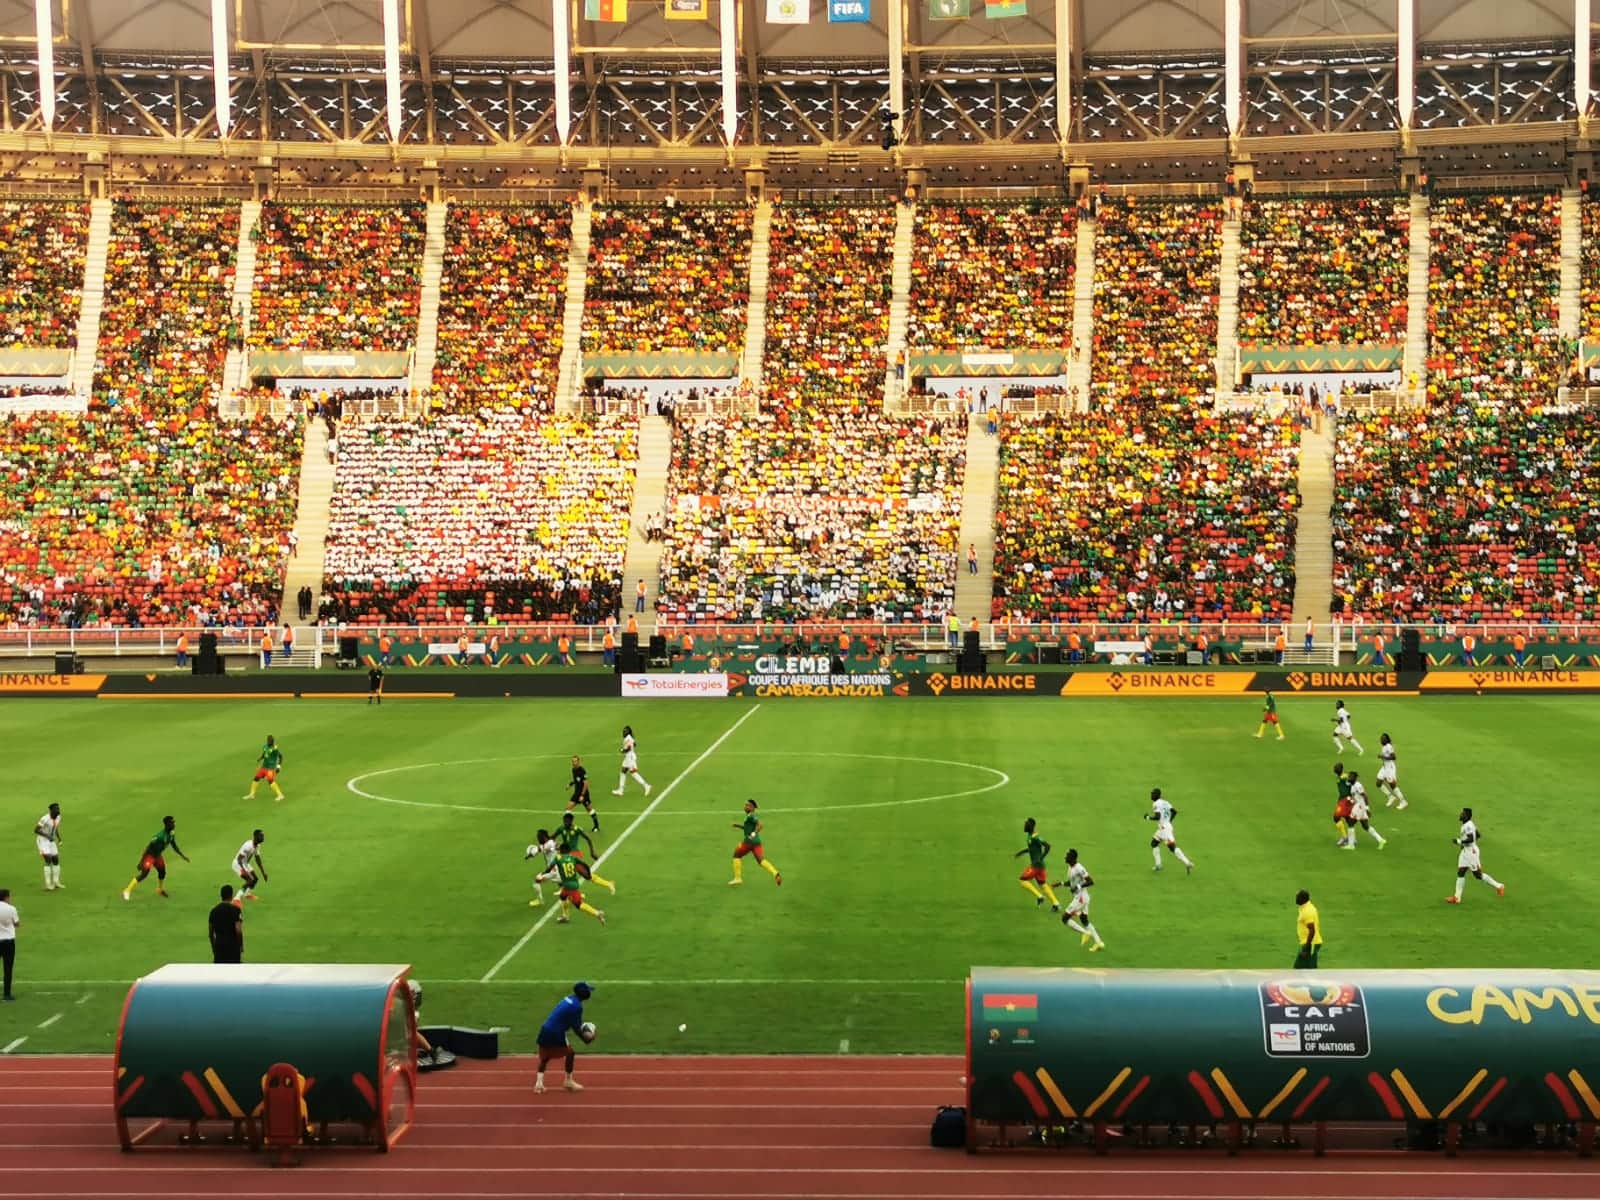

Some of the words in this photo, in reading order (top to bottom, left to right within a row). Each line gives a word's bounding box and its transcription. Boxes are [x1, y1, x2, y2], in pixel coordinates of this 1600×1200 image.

[834, 3, 864, 15] FIFA
[748, 675, 780, 686] COUPE
[781, 675, 830, 686] D'AFRIQUE
[831, 675, 850, 686] DES
[851, 675, 892, 686] NATIONS
[951, 675, 1036, 689] BINANCE
[1131, 674, 1215, 687] BINANCE
[1311, 672, 1397, 686] BINANCE
[1494, 671, 1579, 682] BINANCE
[651, 680, 722, 691] TotalEnergies
[1284, 1006, 1343, 1018] CAF
[1303, 1023, 1335, 1032] AFRICA
[1304, 1032, 1322, 1041] CUP
[1305, 1043, 1317, 1052] OF
[1318, 1043, 1355, 1052] NATIONS
